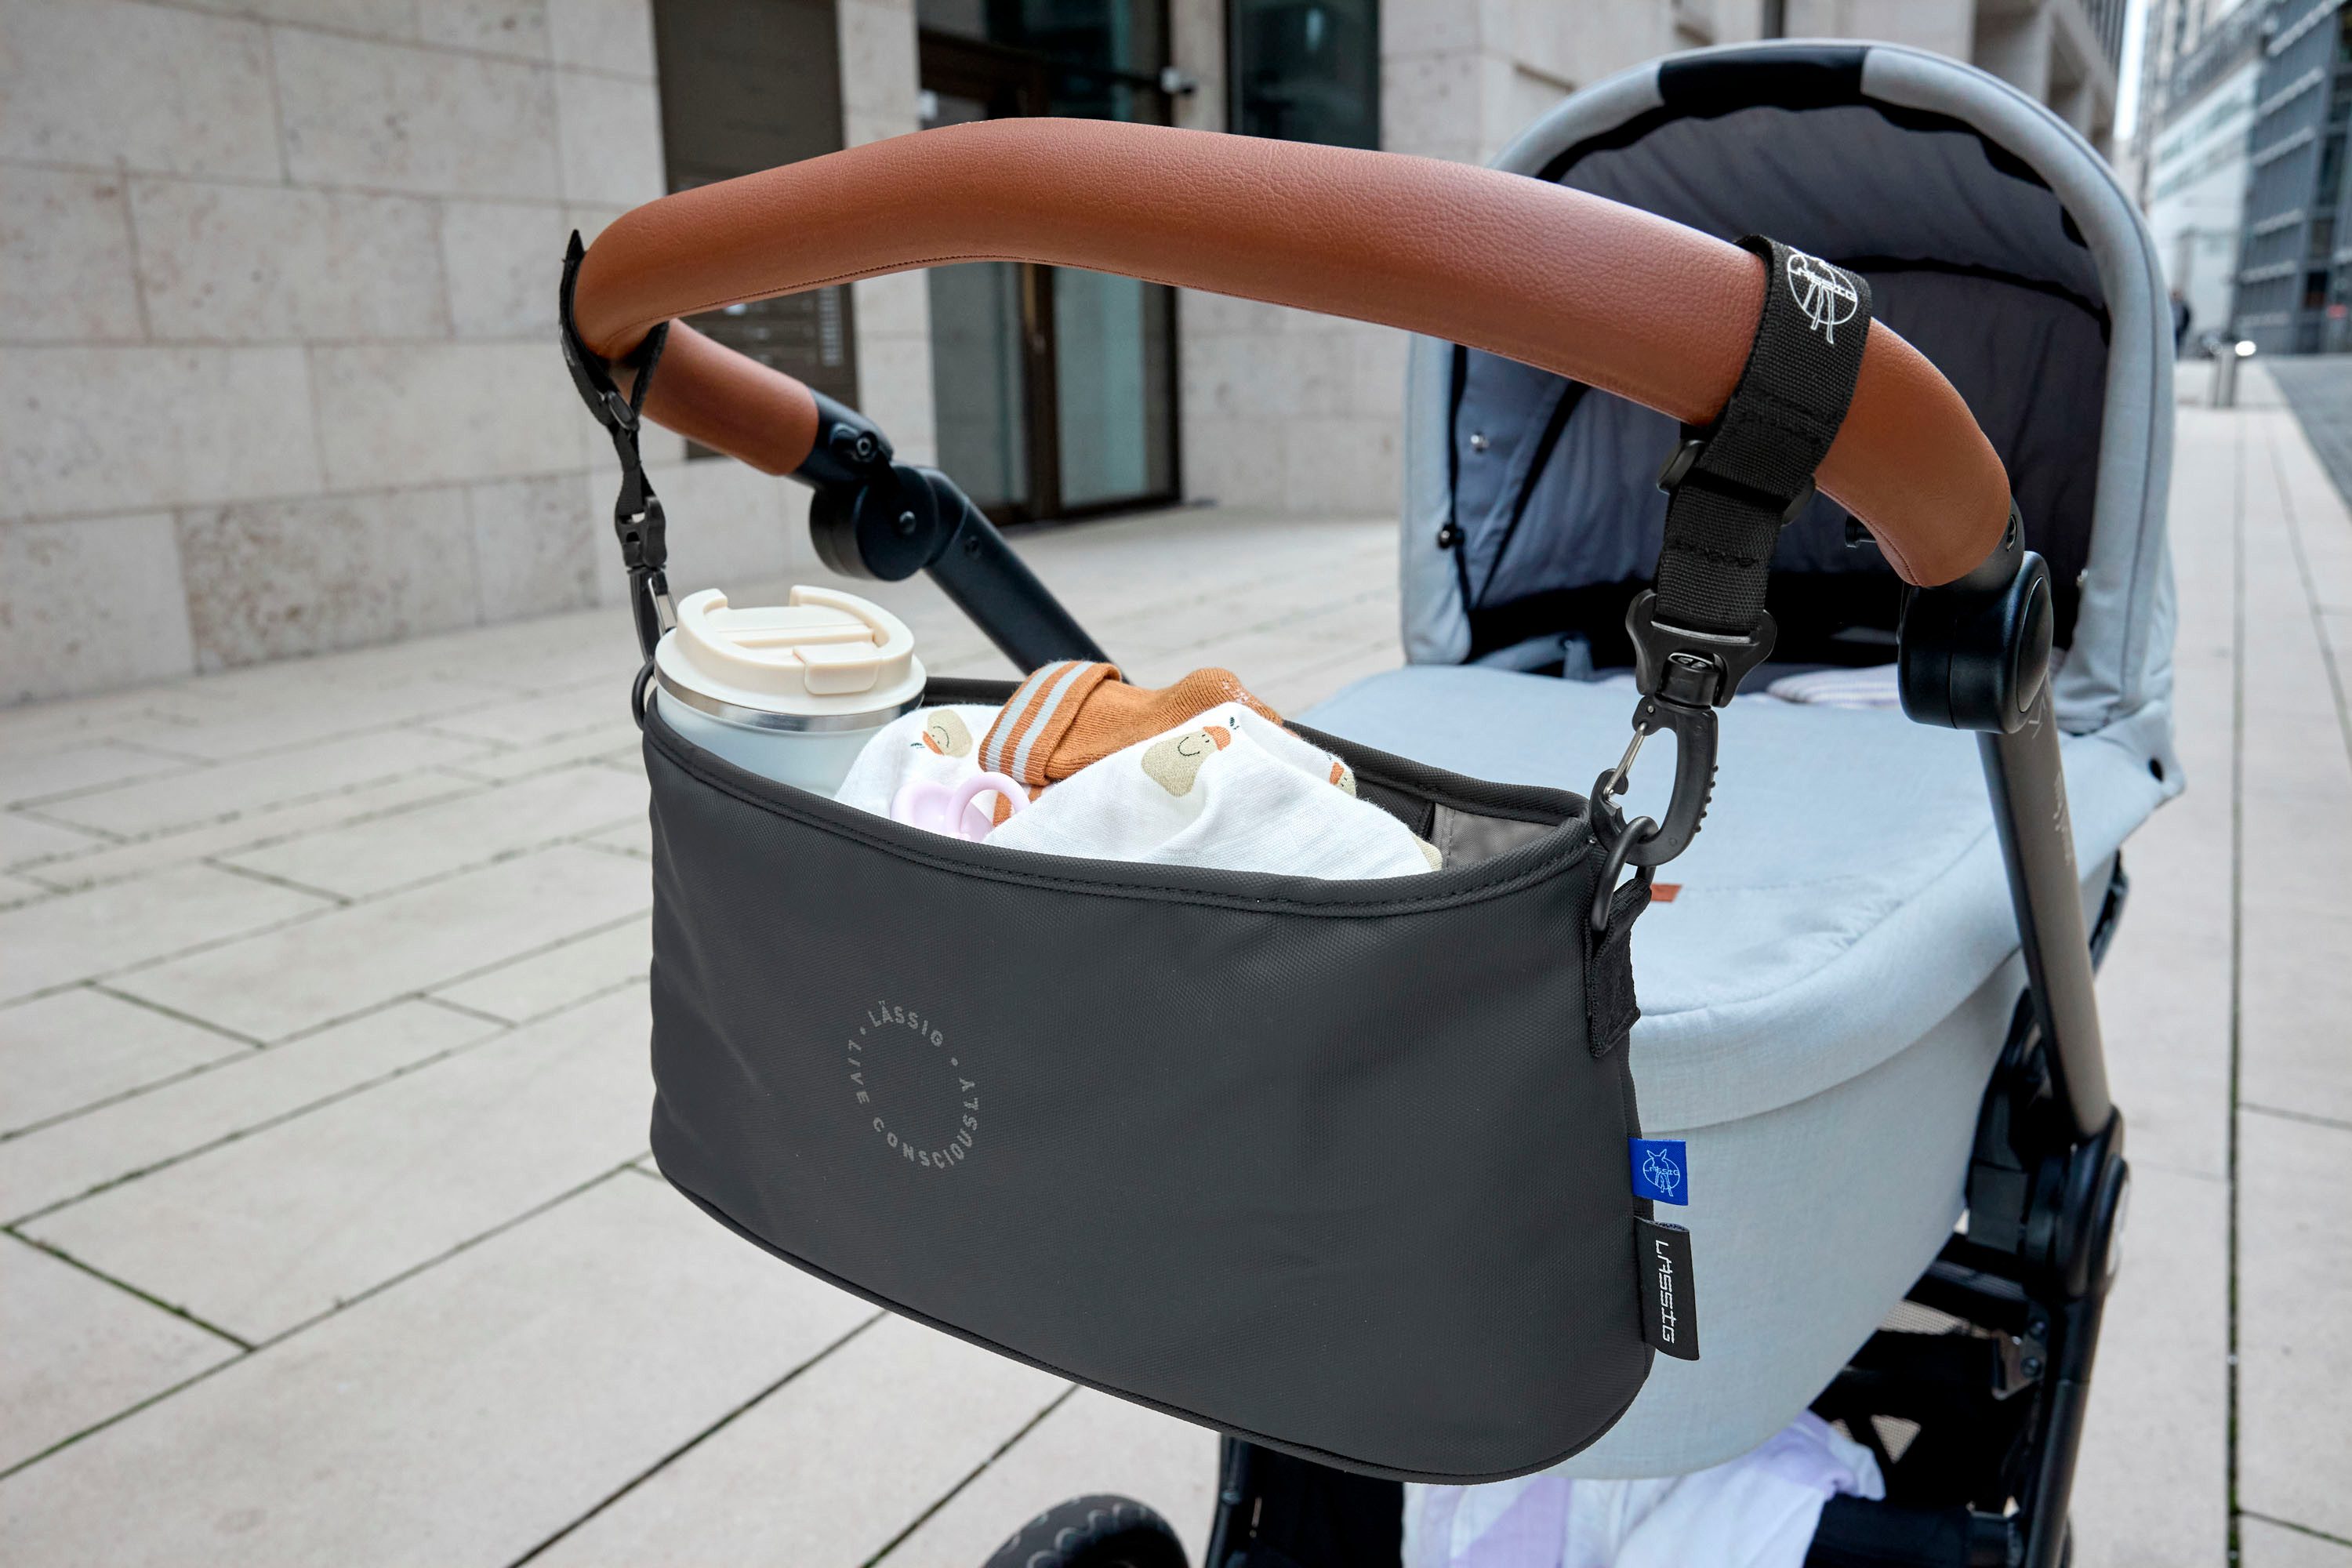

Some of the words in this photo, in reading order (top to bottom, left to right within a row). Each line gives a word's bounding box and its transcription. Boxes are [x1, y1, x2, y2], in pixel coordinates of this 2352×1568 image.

[868, 1000, 943, 1047] LÄSSIG
[848, 1039, 871, 1104] LIVE
[873, 1077, 979, 1169] CONSCIOUSLY
